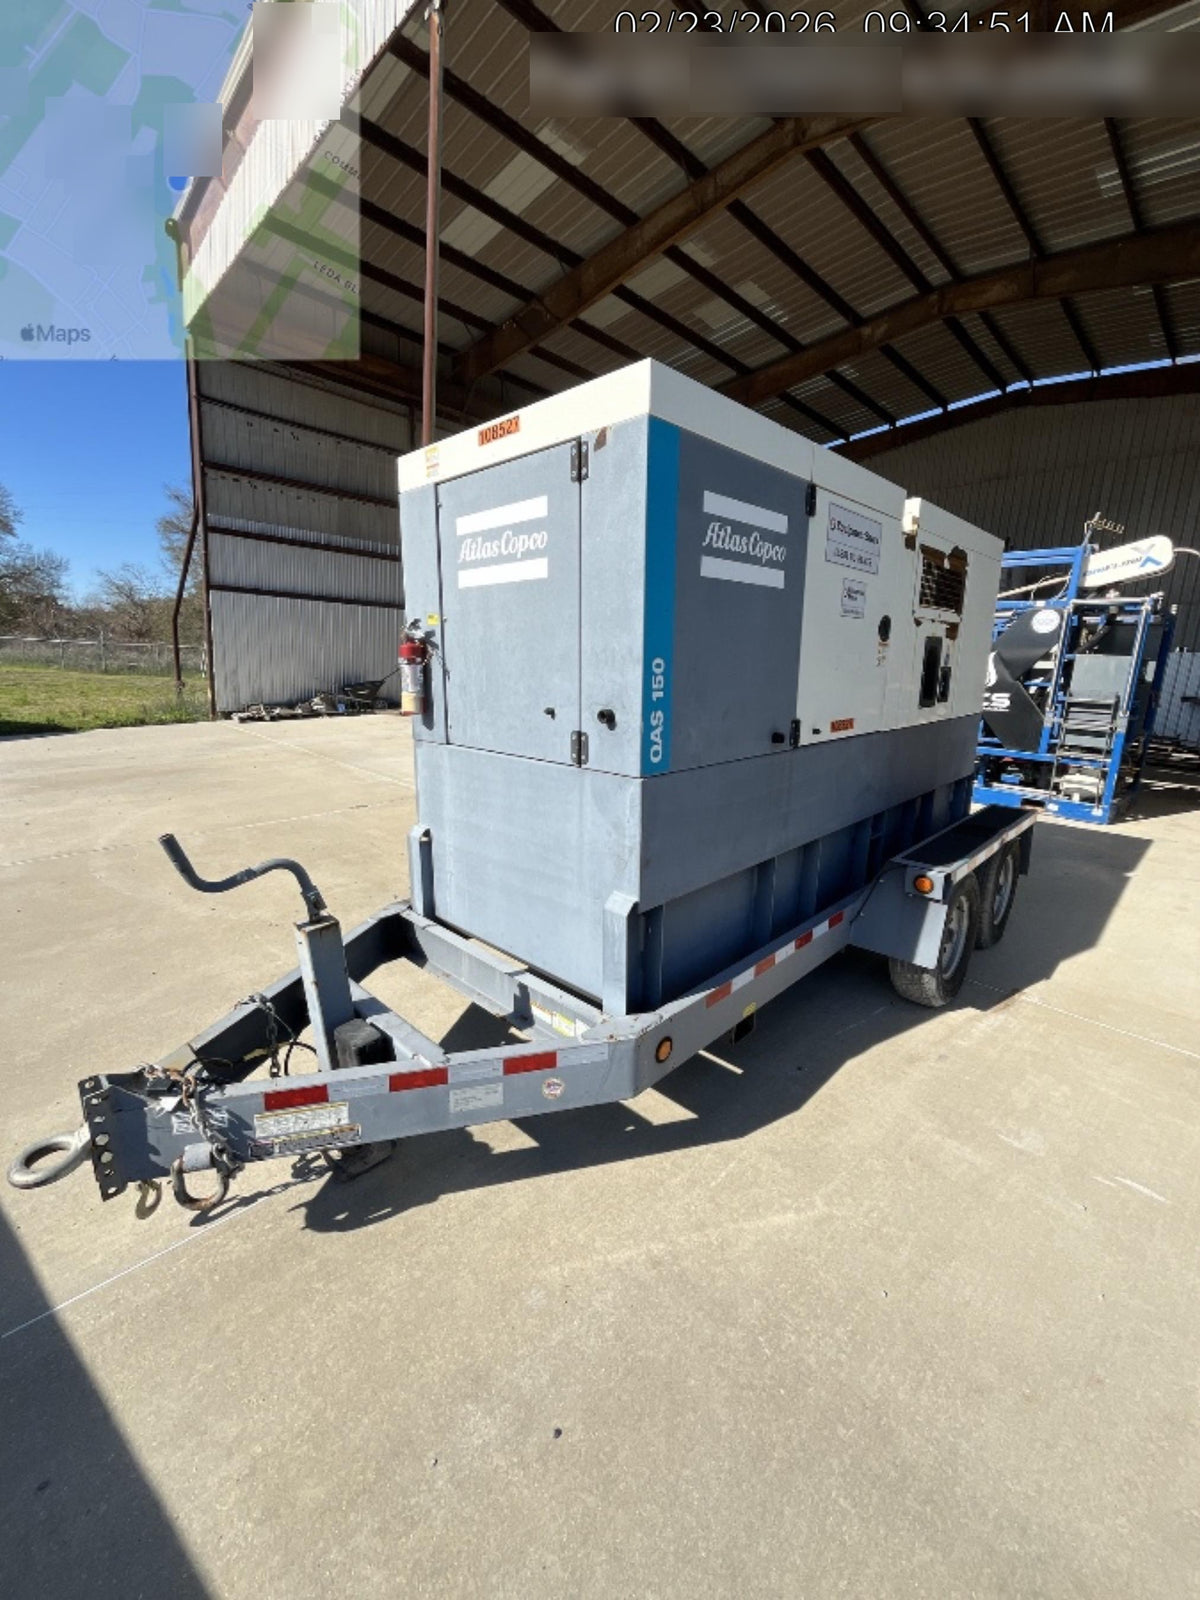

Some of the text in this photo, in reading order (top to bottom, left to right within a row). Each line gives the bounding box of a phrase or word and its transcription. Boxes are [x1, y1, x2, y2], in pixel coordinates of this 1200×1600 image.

[478, 415, 520, 446] 108527
[650, 657, 665, 763] QAS 150
